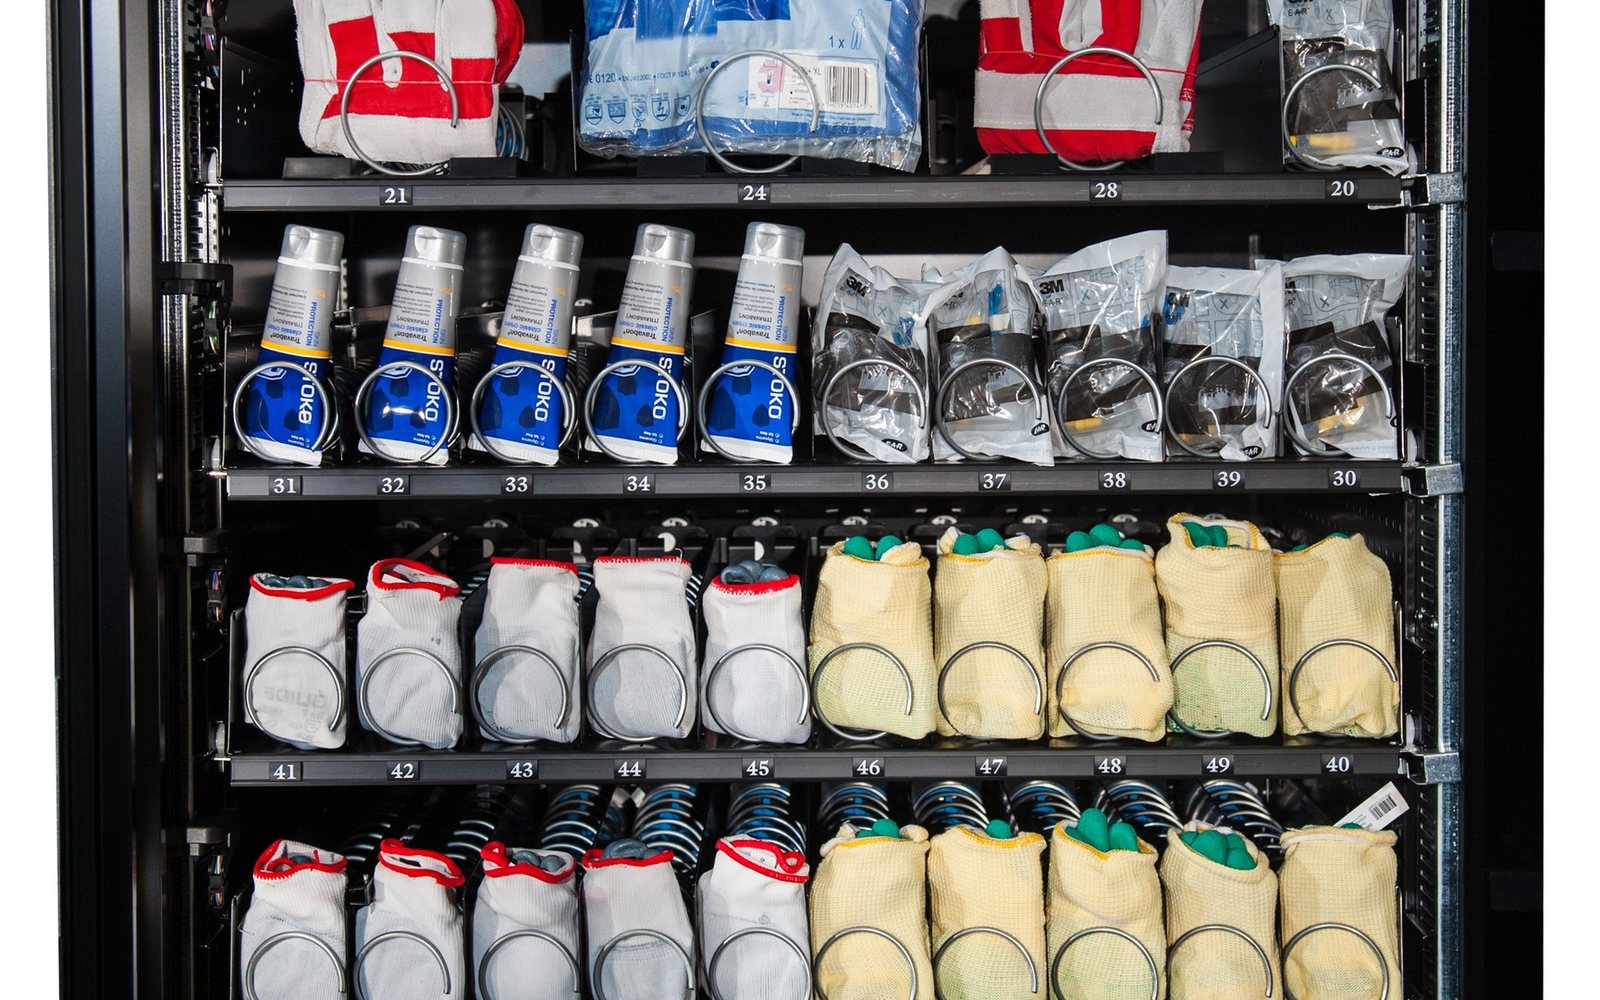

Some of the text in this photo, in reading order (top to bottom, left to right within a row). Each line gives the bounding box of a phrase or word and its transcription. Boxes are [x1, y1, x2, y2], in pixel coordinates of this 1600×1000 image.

[829, 36, 834, 48] 1
[595, 73, 616, 84] 0120
[385, 188, 407, 203] 21
[743, 185, 766, 200] 24
[1095, 183, 1117, 198] 28
[1331, 181, 1354, 196] 20
[846, 276, 868, 297] 3M
[1039, 280, 1064, 294] 3M
[306, 302, 317, 346] PROTECTION
[545, 300, 557, 343] PROTECTION
[662, 298, 672, 341] PROTECTION
[775, 296, 785, 340] PROTECTION
[425, 359, 444, 422] SOKO
[769, 356, 787, 419] SOKO
[273, 478, 295, 493] 31
[382, 477, 404, 493] 32
[506, 477, 527, 492] 33
[627, 476, 650, 491] 34
[744, 474, 766, 490] 35
[866, 474, 888, 489] 36
[984, 473, 1006, 488] 37
[1104, 472, 1125, 487] 38
[1218, 471, 1240, 486] 39
[1333, 471, 1356, 486] 30
[273, 764, 296, 779] 41
[391, 763, 414, 778] 42
[511, 762, 533, 777] 43
[618, 761, 641, 776] 44
[746, 760, 769, 775] 45
[857, 759, 881, 775] 46
[980, 757, 1004, 774] 47
[1099, 758, 1121, 773] 48
[1207, 757, 1230, 772] 49
[1326, 757, 1349, 771] 40
